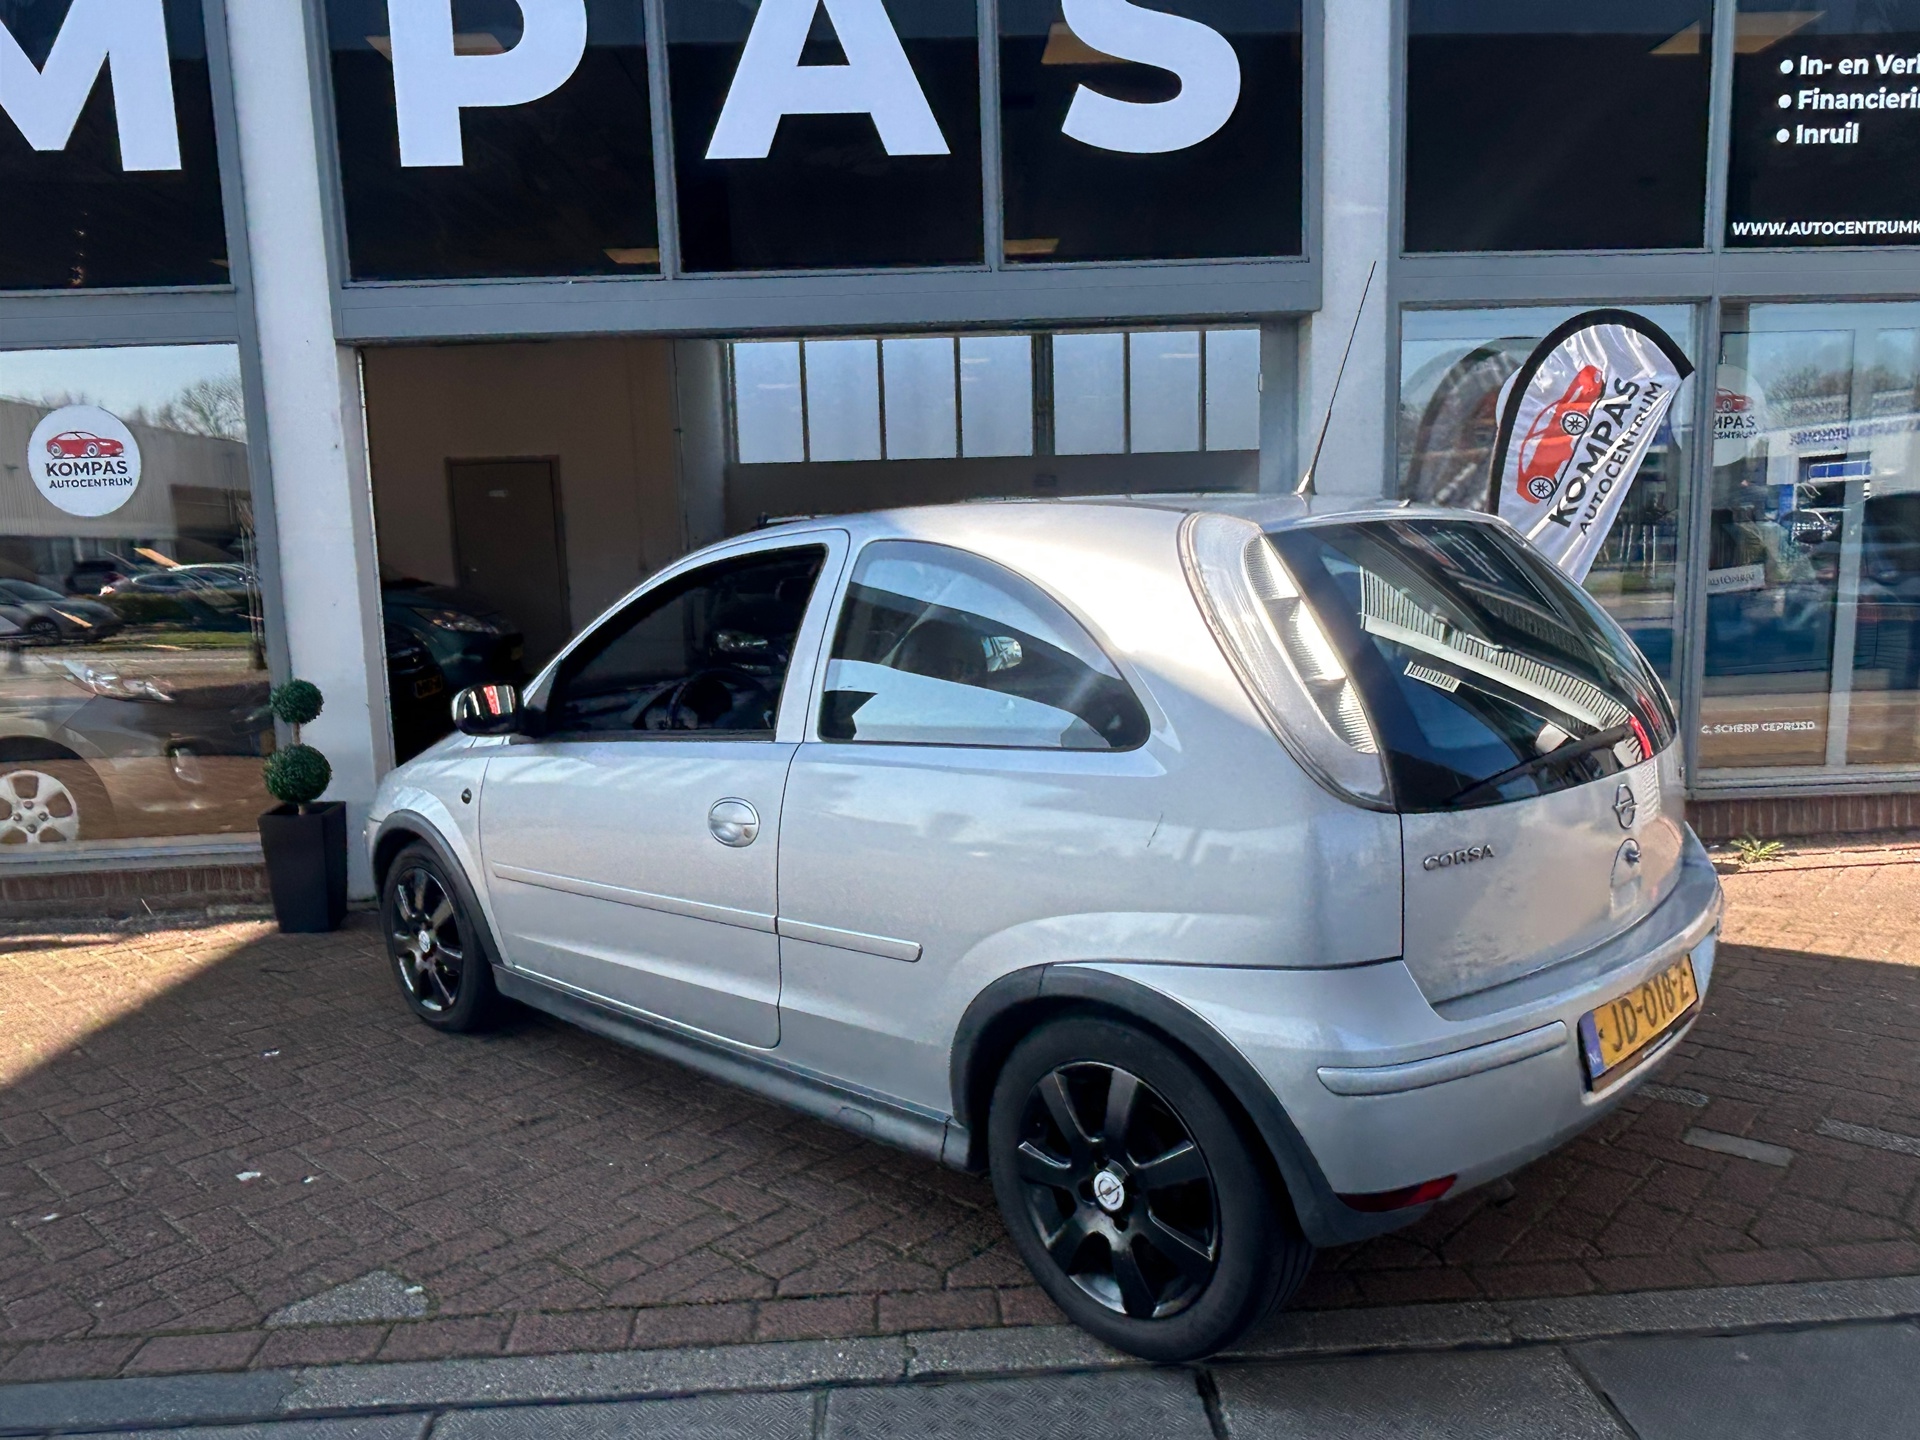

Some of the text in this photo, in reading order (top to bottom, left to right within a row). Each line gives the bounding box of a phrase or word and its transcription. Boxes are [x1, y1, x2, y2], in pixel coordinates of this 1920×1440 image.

[1800, 55, 1831, 75] In-
[1838, 57, 1869, 75] en
[1798, 86, 1920, 110] Financieri
[1796, 122, 1859, 144] Inruil
[1549, 377, 1640, 528] KOMPAS
[1579, 381, 1663, 536] AUTOCENTRUM
[45, 460, 129, 477] KOMPAS
[49, 475, 133, 490] AUTOCENTRUM
[1714, 723, 1759, 734] SCHERP
[1423, 844, 1495, 872] CORSA
